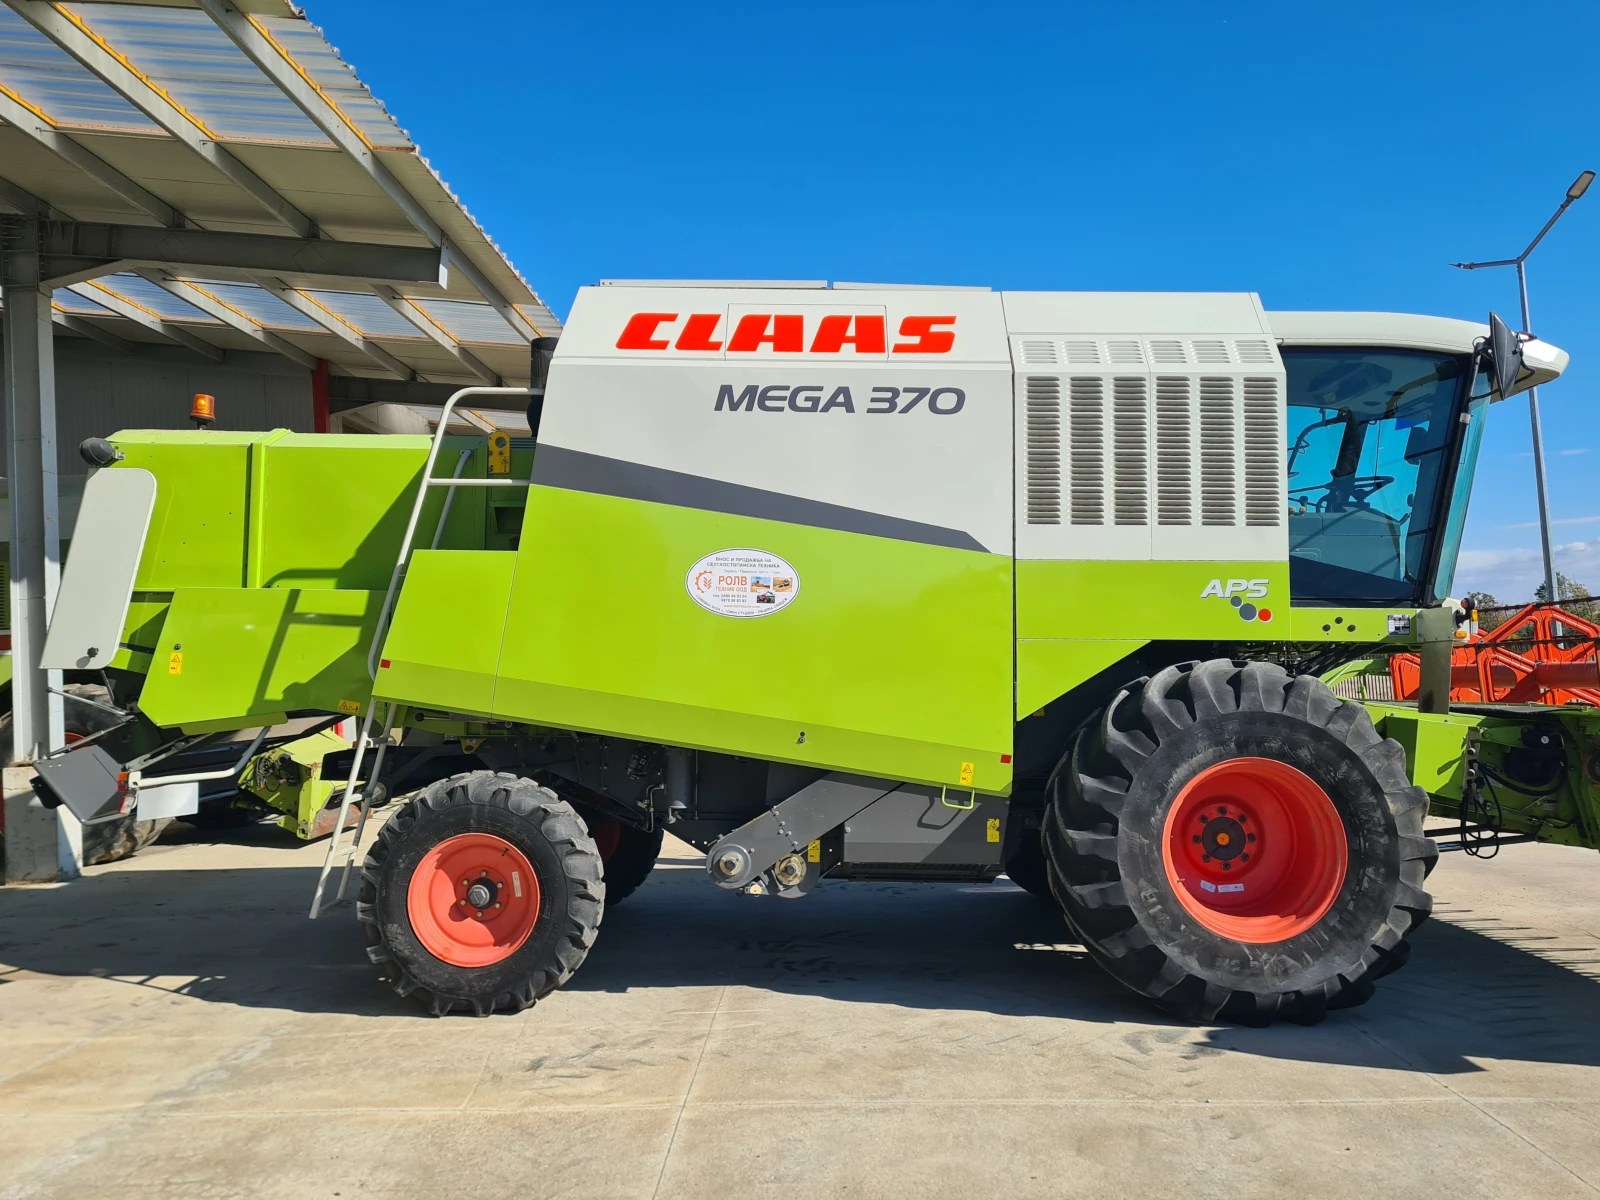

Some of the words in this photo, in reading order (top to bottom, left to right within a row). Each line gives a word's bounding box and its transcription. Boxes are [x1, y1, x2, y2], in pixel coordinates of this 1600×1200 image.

[615, 312, 957, 353] CLAAS
[714, 384, 856, 413] MEGA
[866, 386, 966, 415] 370
[718, 575, 748, 586] РОЛВ
[1200, 579, 1270, 598] APS
